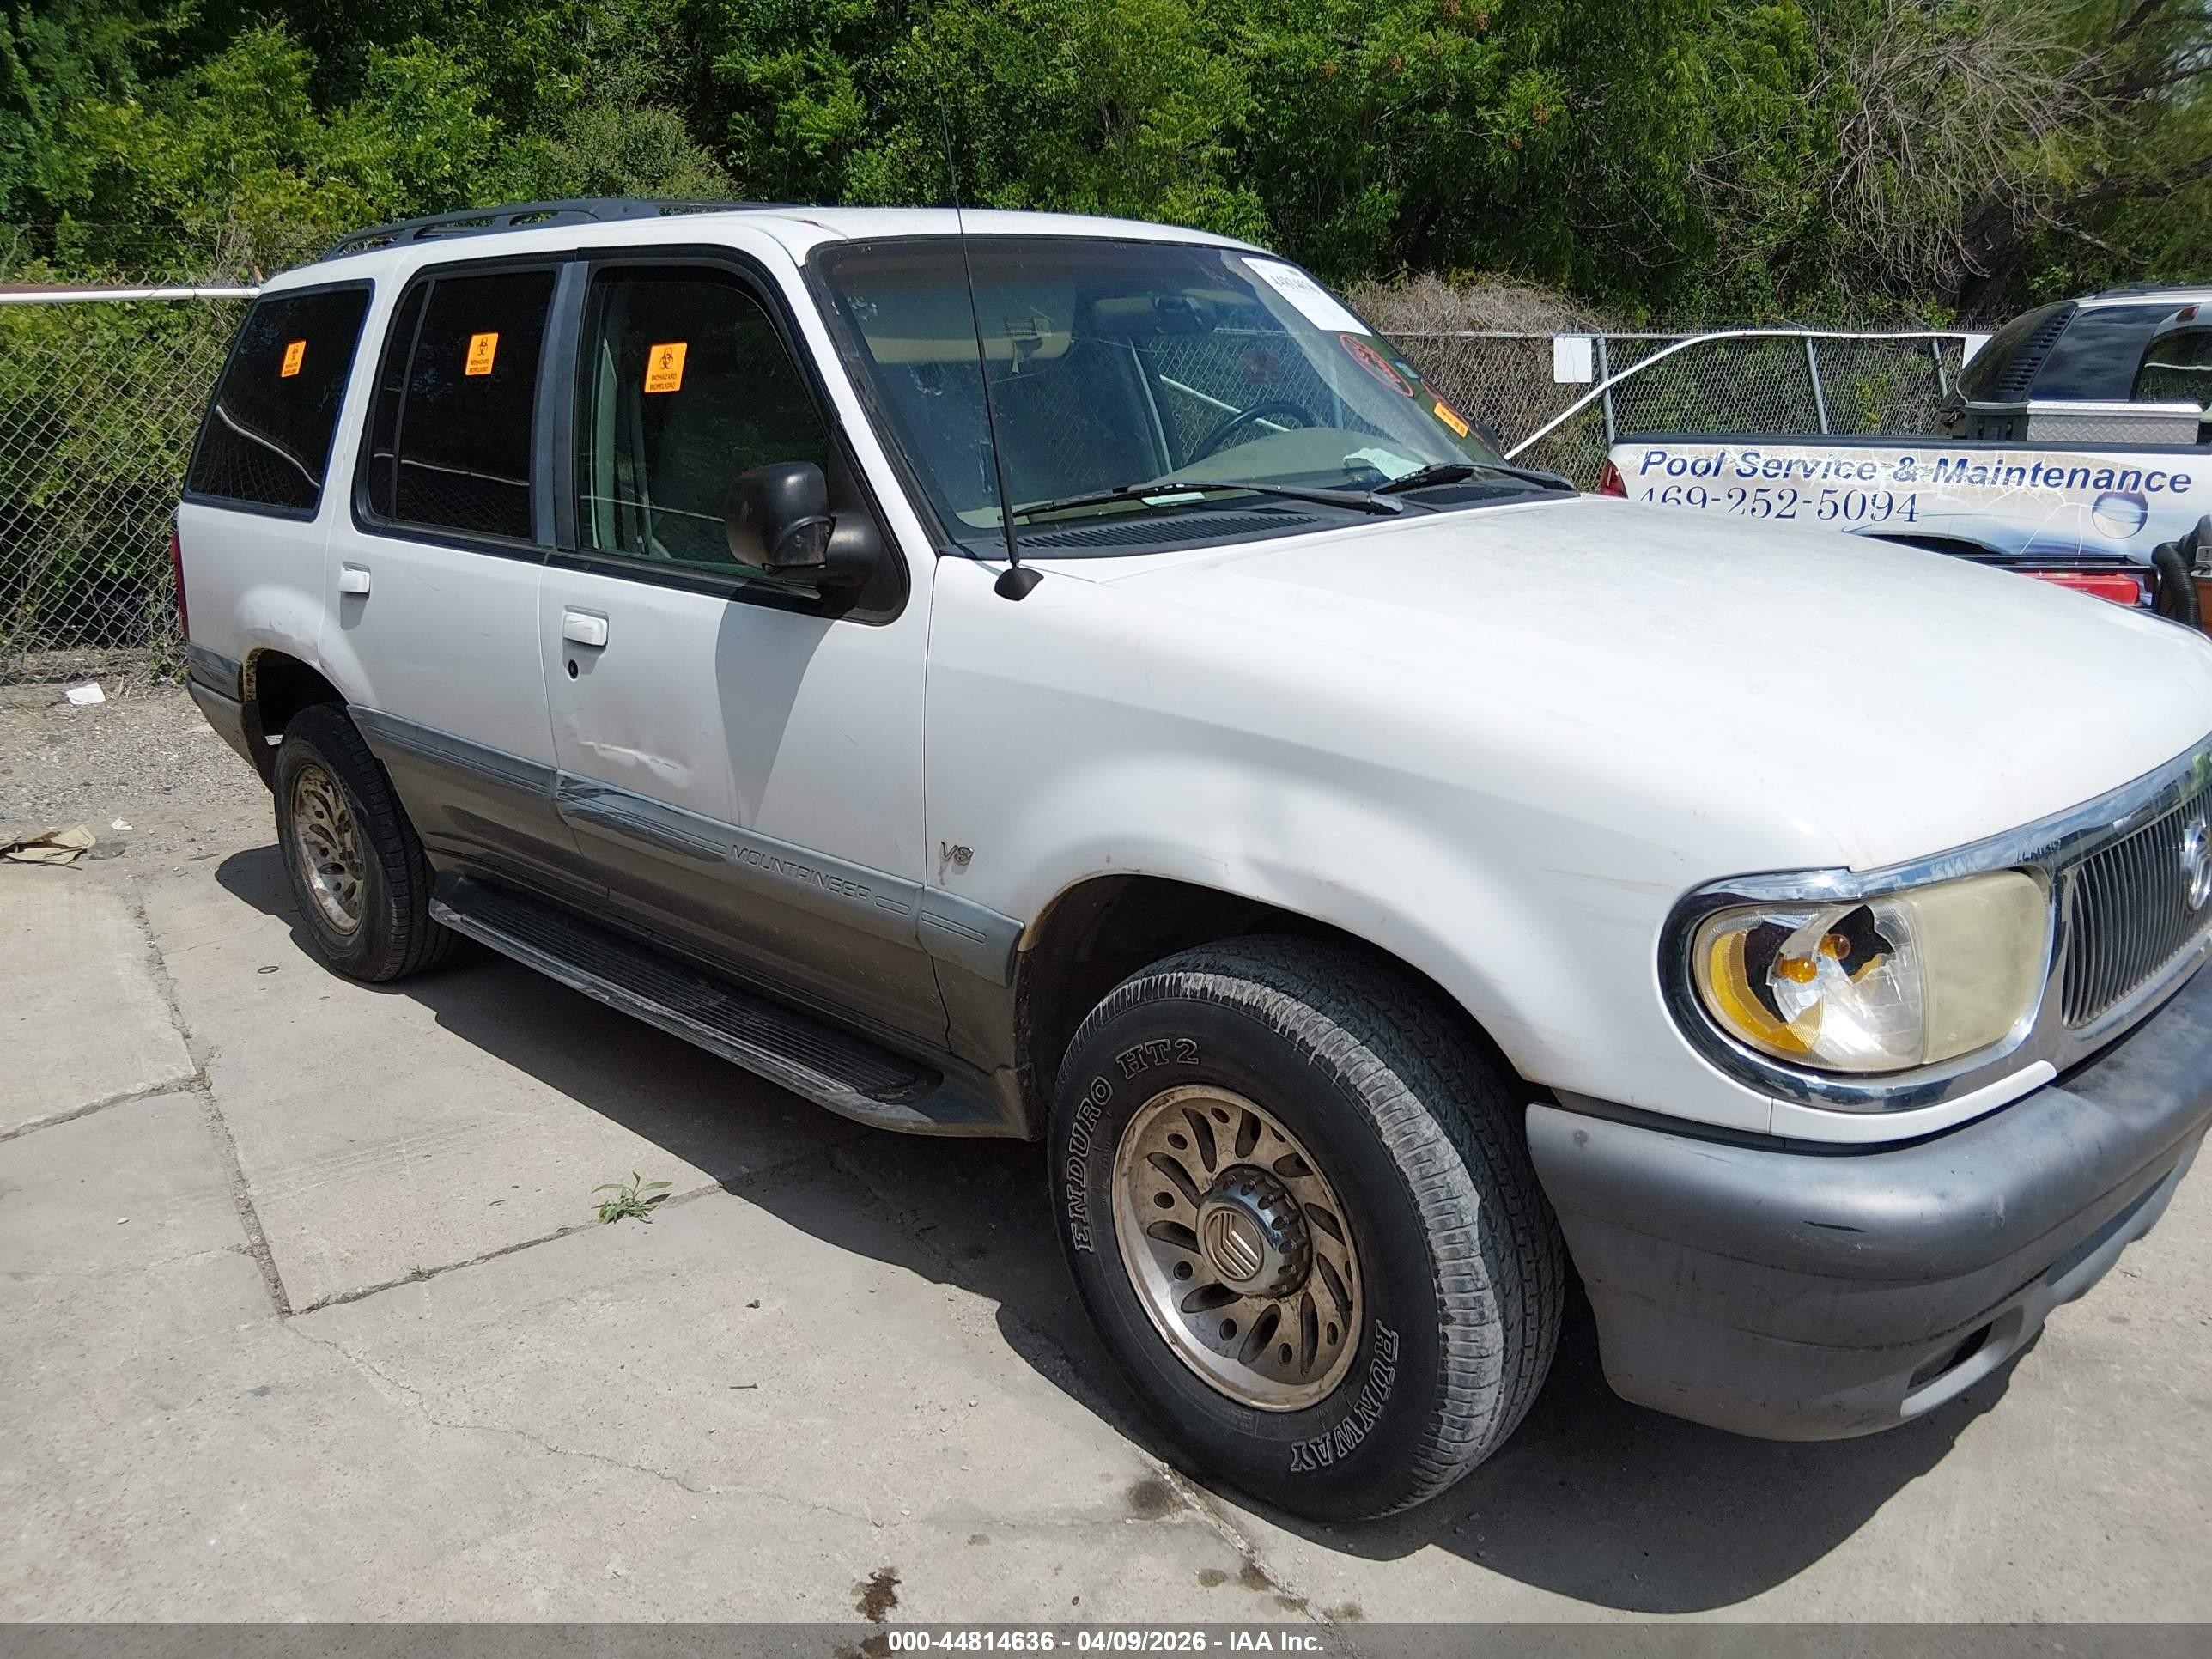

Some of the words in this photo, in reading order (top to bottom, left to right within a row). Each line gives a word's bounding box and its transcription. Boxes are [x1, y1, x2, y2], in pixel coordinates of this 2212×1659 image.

[1639, 450, 1725, 477] Pool
[1735, 451, 1878, 481] Service
[1892, 455, 1918, 483] &
[1931, 457, 2192, 494] Maintenance
[732, 844, 872, 901] MOUNTAINEER
[940, 841, 974, 866] V8
[1062, 1075, 1113, 1253] ENDURO
[1116, 1038, 1200, 1079] HT2
[1290, 1318, 1401, 1473] RUNWAY
